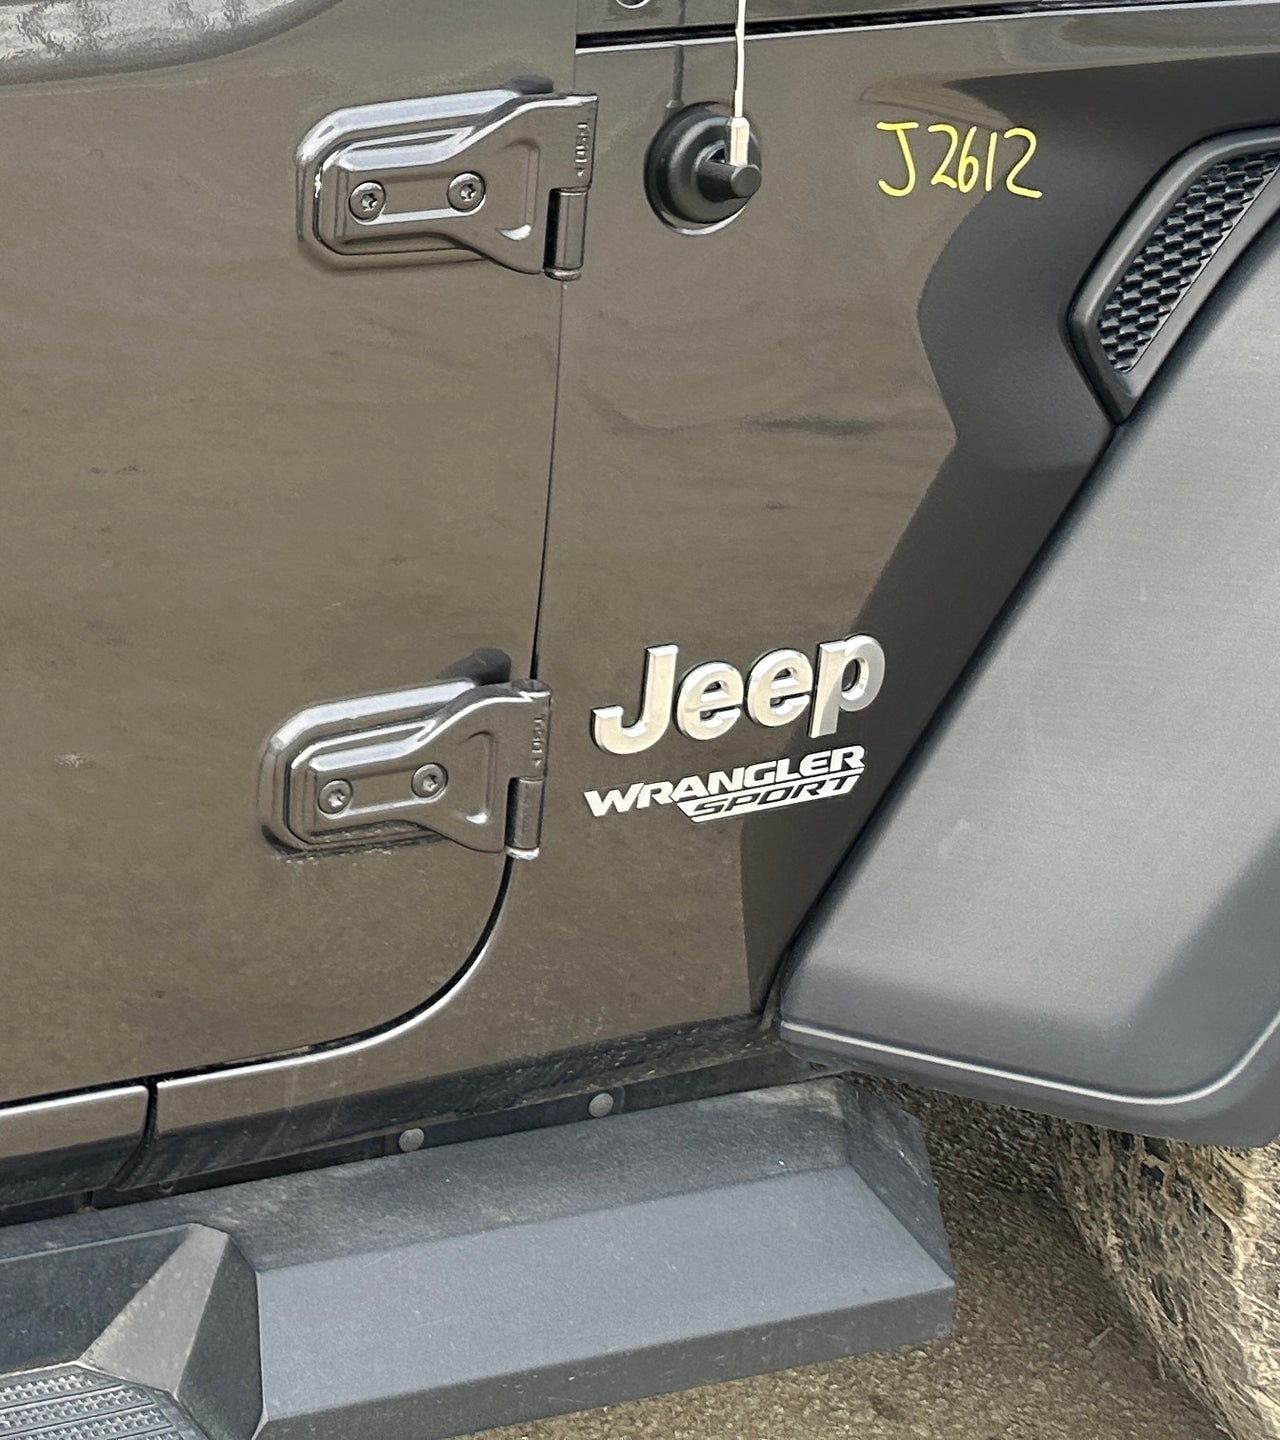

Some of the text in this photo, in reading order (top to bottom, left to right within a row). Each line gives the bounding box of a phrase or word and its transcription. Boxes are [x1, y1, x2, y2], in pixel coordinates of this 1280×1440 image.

[875, 121, 1043, 199] J2612
[591, 632, 886, 755] Jeep
[583, 744, 866, 818] WRANGLER
[690, 772, 861, 818] SPORT
